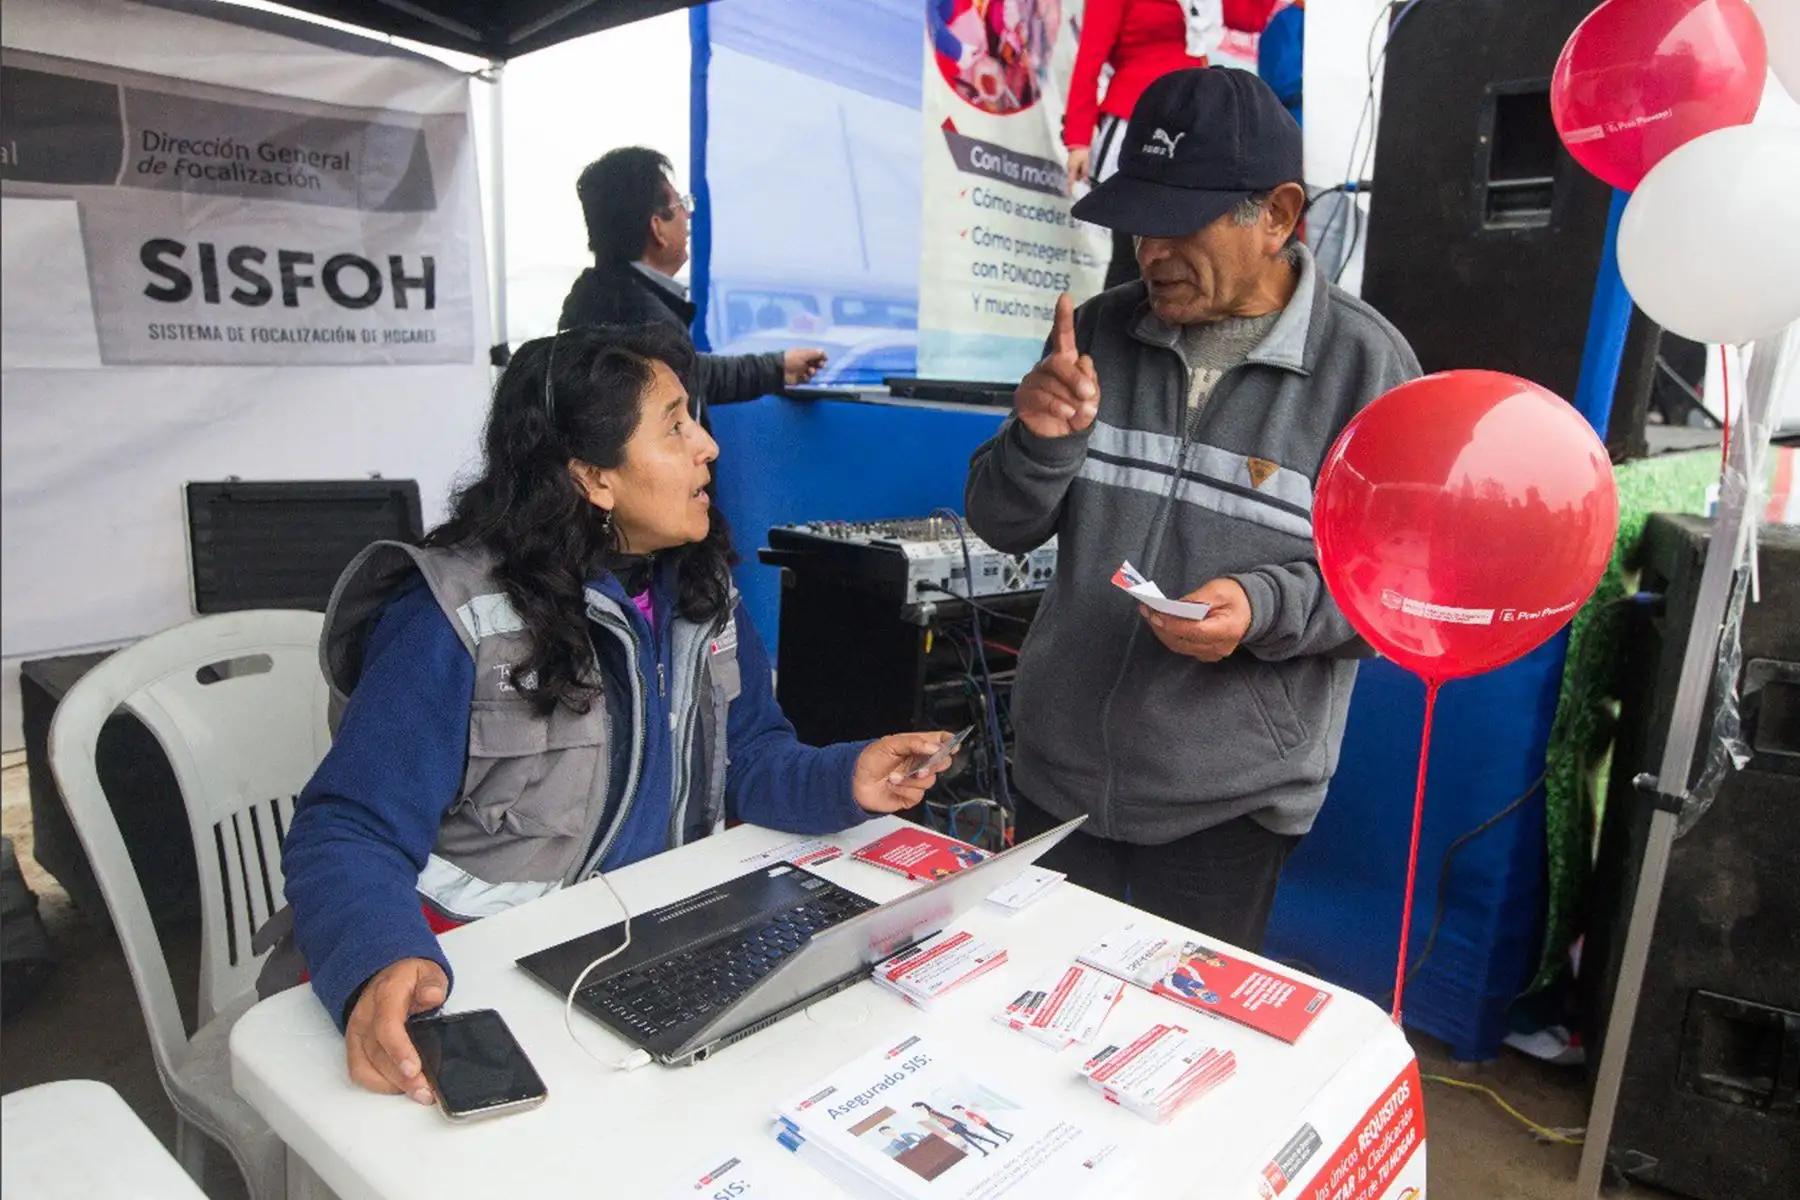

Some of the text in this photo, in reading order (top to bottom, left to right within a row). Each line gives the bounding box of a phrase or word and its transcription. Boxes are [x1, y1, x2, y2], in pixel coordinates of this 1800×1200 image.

[143, 130, 351, 170] Dirección General
[970, 145, 1000, 172] Con
[138, 158, 322, 190] de Focalización
[972, 187, 1012, 214] Cómo
[1014, 203, 1067, 228] acceder
[972, 226, 1012, 251] Cómo
[1014, 239, 1067, 265] proteger
[139, 238, 436, 311] SISFOH
[972, 261, 1072, 292] con FONCODES
[971, 290, 982, 312] Y
[985, 298, 1031, 318] mucho
[148, 323, 436, 344] SISTEMA DE FOCALIZACIÓN DE HOGARES
[827, 1071, 906, 1121] Asegurado
[901, 1053, 933, 1074] SIS:
[1357, 1079, 1411, 1154] REQUISITOS
[713, 1179, 751, 1200] SIS:
